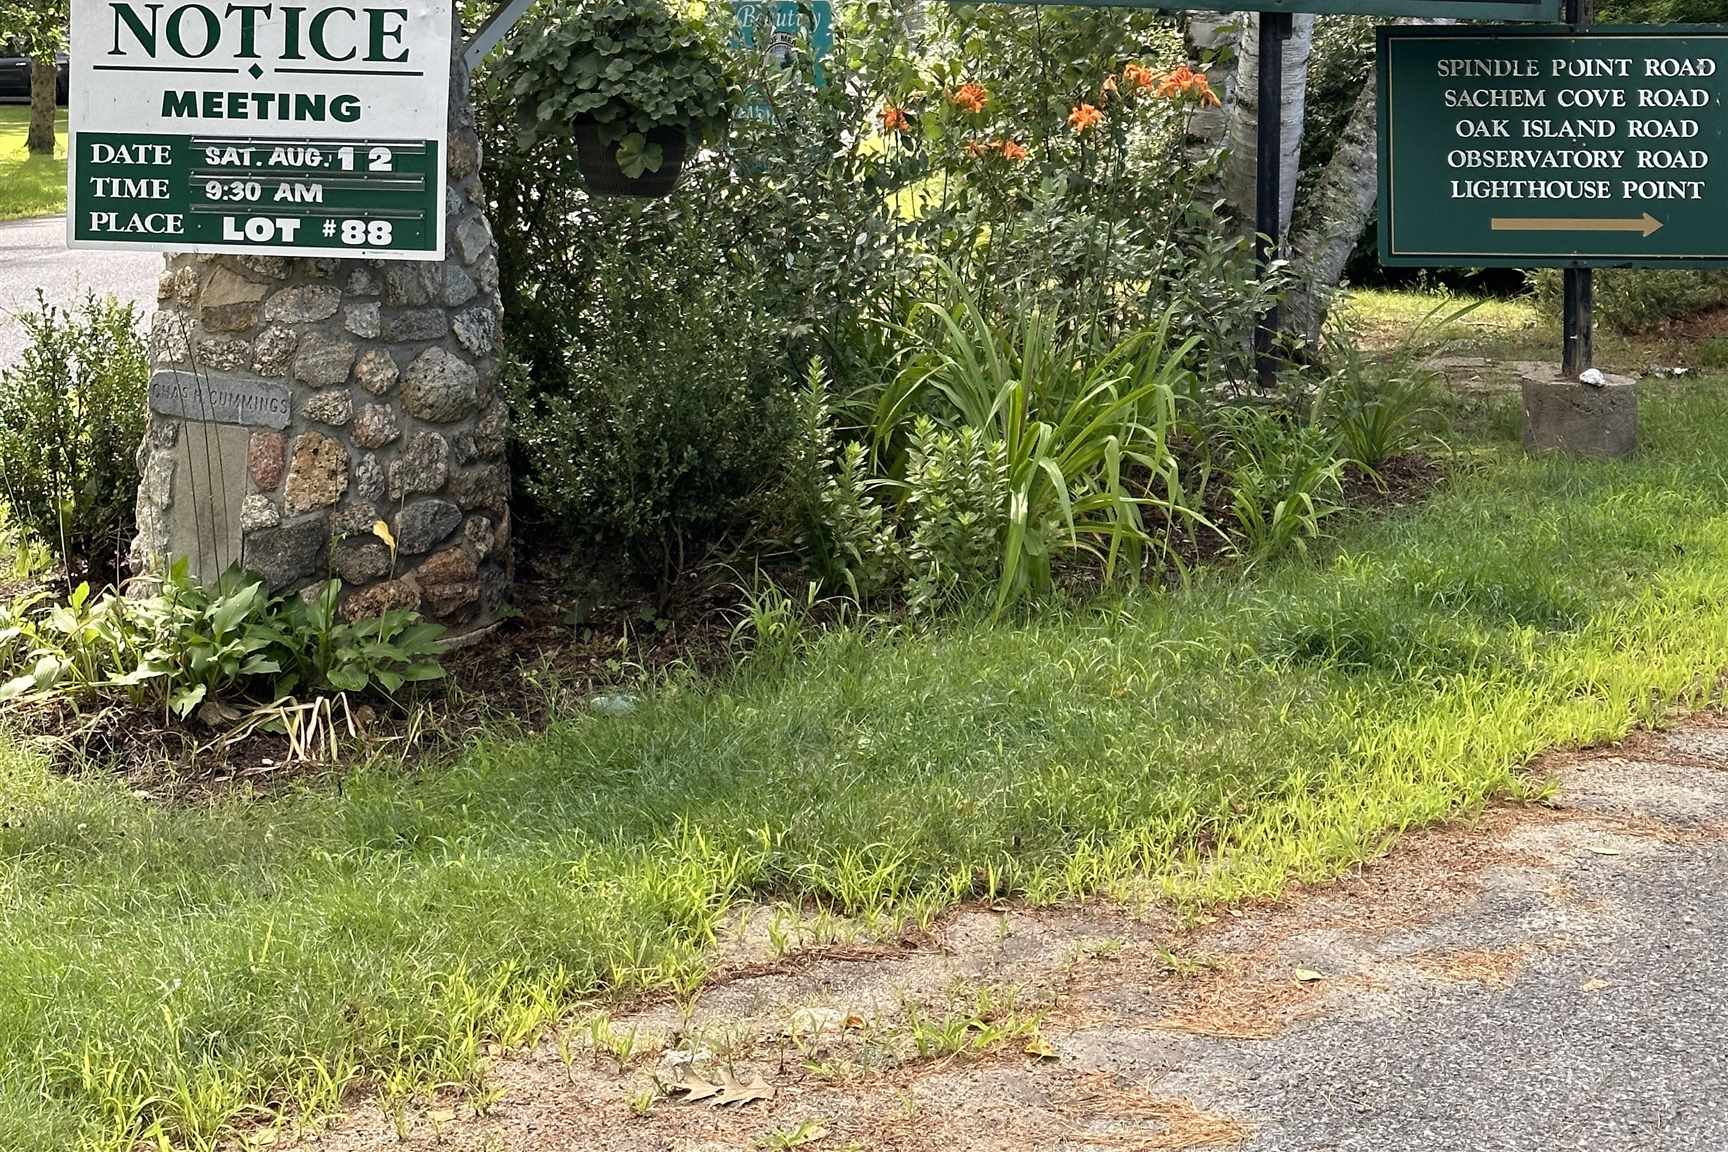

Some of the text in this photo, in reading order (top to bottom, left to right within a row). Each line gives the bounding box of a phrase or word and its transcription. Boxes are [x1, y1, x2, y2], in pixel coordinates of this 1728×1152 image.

[108, 3, 409, 62] NOTICE
[1438, 58, 1716, 77] SPINDLE POINT ROAD
[162, 90, 360, 122] MEETING
[1445, 89, 1709, 108] SACHEM COVE ROAD
[1456, 119, 1699, 139] OAK ISLAND ROAD
[90, 143, 172, 165] DATE
[205, 147, 263, 167] SAT.
[269, 147, 330, 168] AUG.
[1447, 149, 1708, 169] OBSERVATORY ROAD
[90, 177, 323, 203] TIME 9:30 AM
[1450, 180, 1705, 200] LIGHTHOUSE POINT
[89, 211, 392, 246] PLACE LOT #88
[210, 390, 288, 414] CUMMINGS
